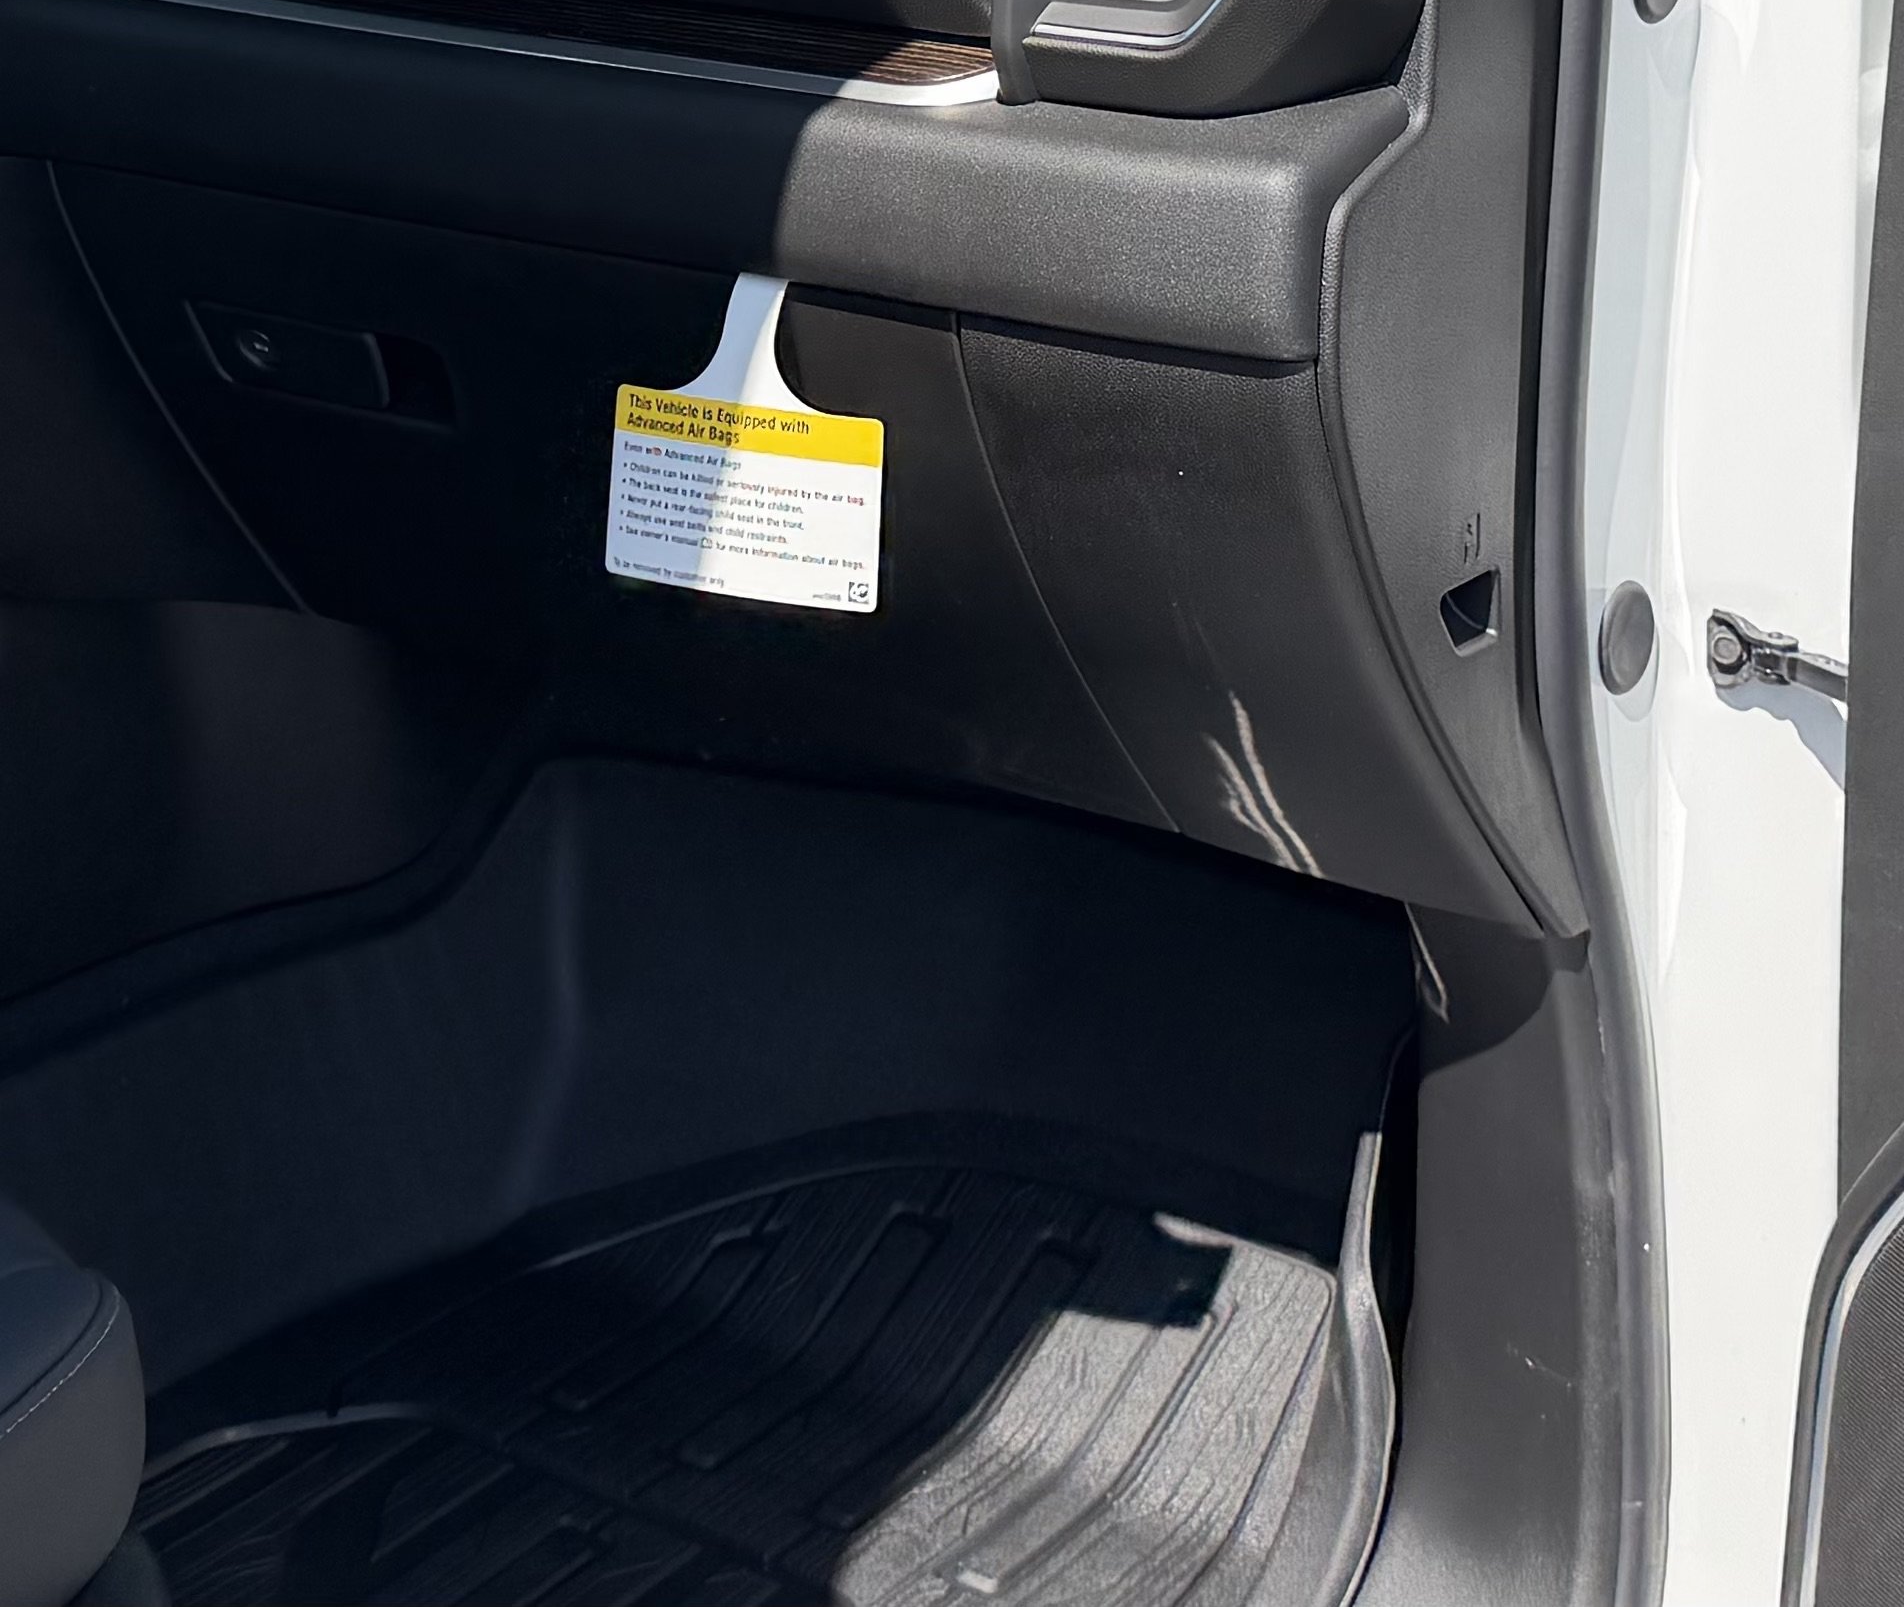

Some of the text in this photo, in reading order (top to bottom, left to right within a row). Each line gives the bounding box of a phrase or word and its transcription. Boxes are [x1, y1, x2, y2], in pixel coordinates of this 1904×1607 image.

[627, 412, 739, 446] Advanced Air Bags
[630, 393, 809, 434] This Vehicle is Equipped with
